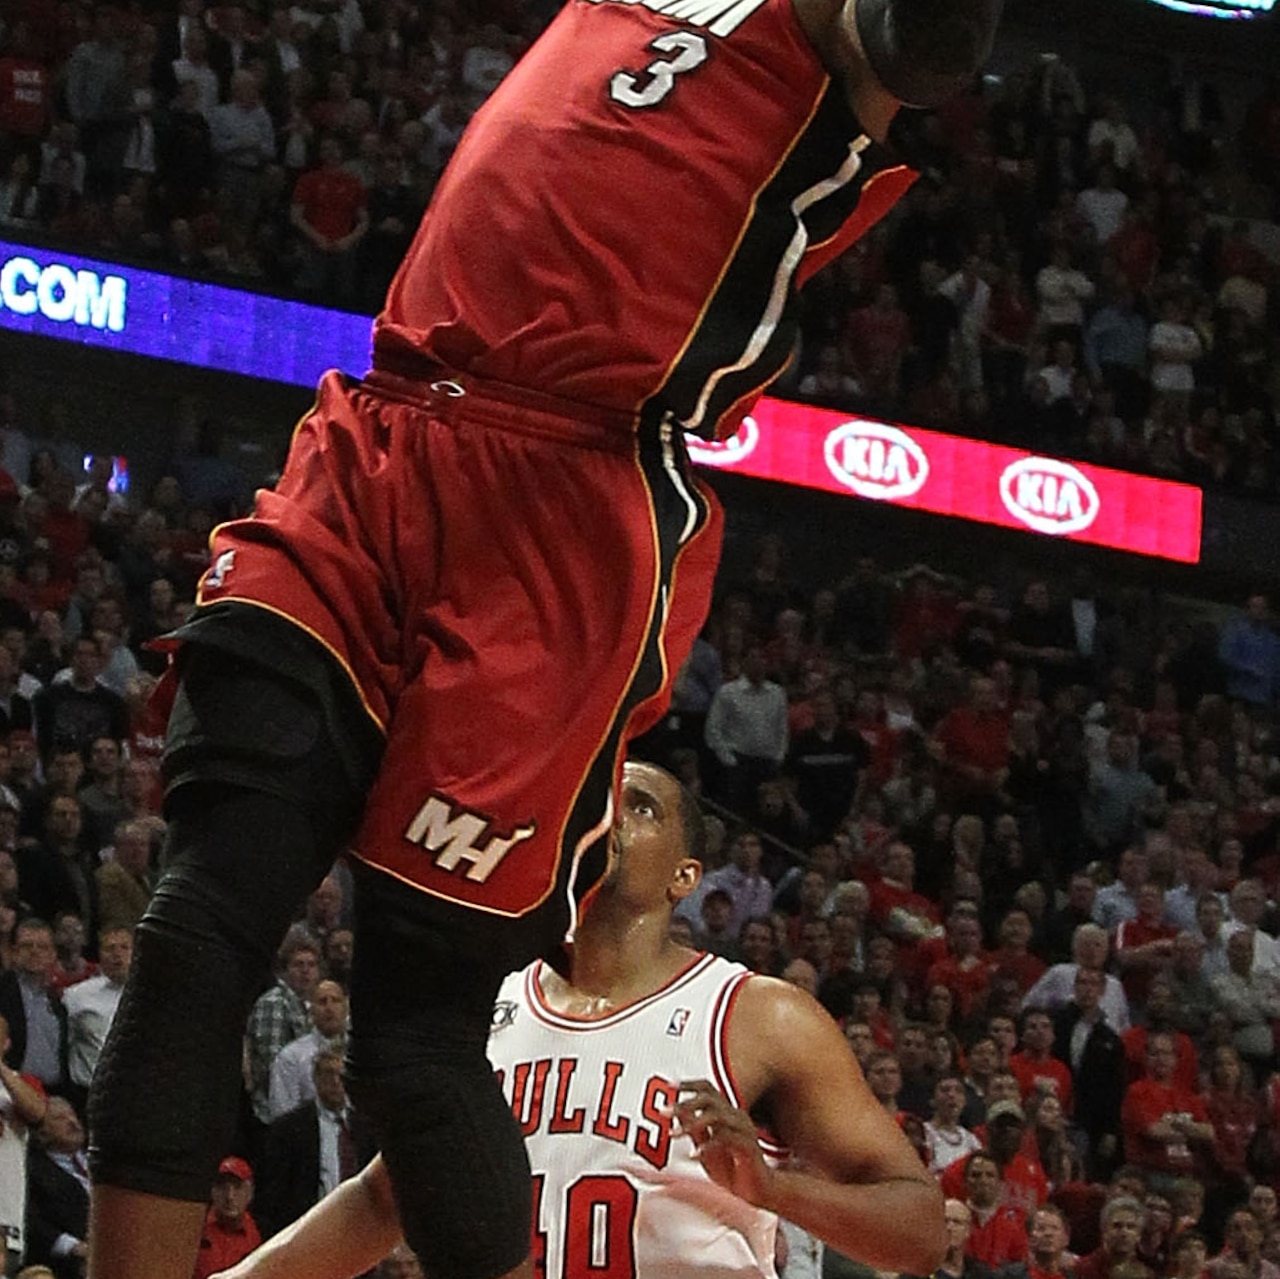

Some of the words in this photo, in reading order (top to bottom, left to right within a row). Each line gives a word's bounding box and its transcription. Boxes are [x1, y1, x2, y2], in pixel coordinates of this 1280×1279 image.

[610, 30, 707, 107] 3
[842, 438, 912, 484] KIA
[1019, 473, 1083, 520] KIA
[497, 1057, 680, 1171] ULLS
